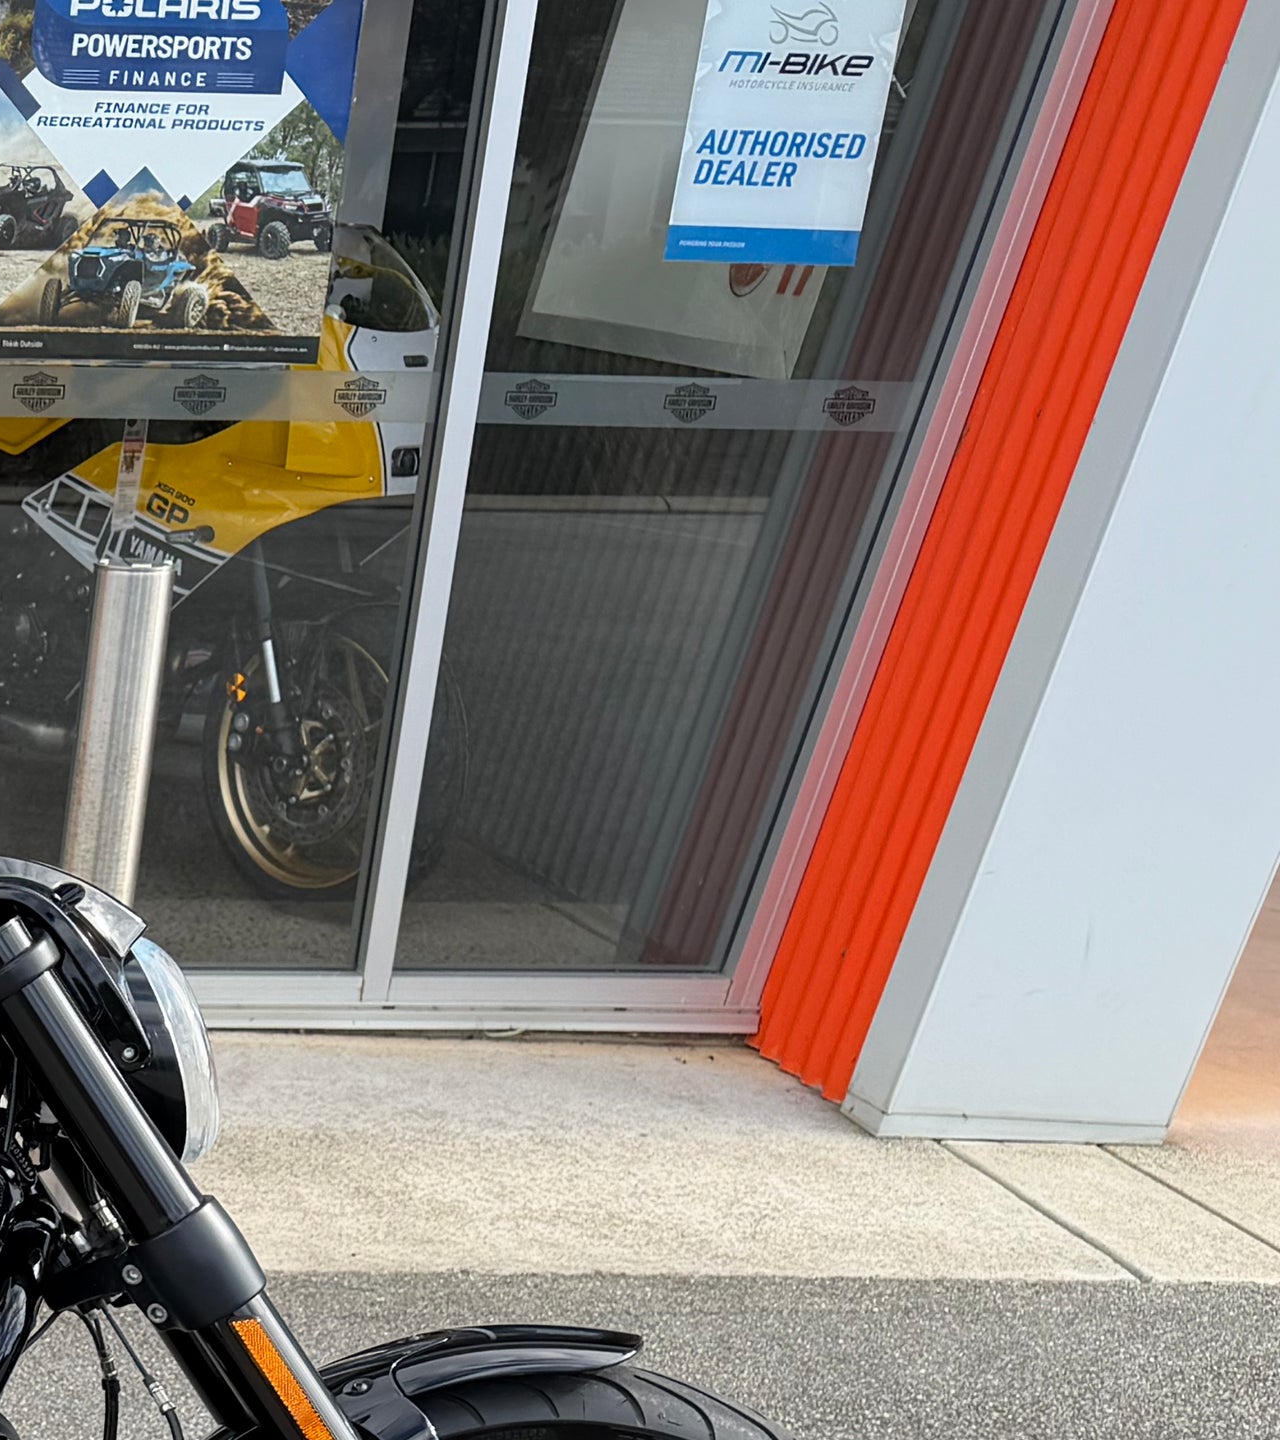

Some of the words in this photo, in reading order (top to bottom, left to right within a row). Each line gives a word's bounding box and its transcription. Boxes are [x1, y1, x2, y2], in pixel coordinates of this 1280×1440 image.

[70, 0, 261, 20] POLARIS
[71, 33, 253, 61] POWERSPORTS
[108, 70, 207, 87] FINANCE
[729, 79, 794, 91] MOTORCYCLE
[796, 81, 856, 93] INSURANCE
[94, 102, 170, 115] FINANCE
[175, 103, 210, 116] FOR
[37, 116, 166, 130] RECREATIONAL
[171, 119, 265, 132] PRODUCTS
[696, 129, 866, 160] AUTHORISED
[692, 159, 798, 187] DEALER
[146, 492, 190, 524] GP
